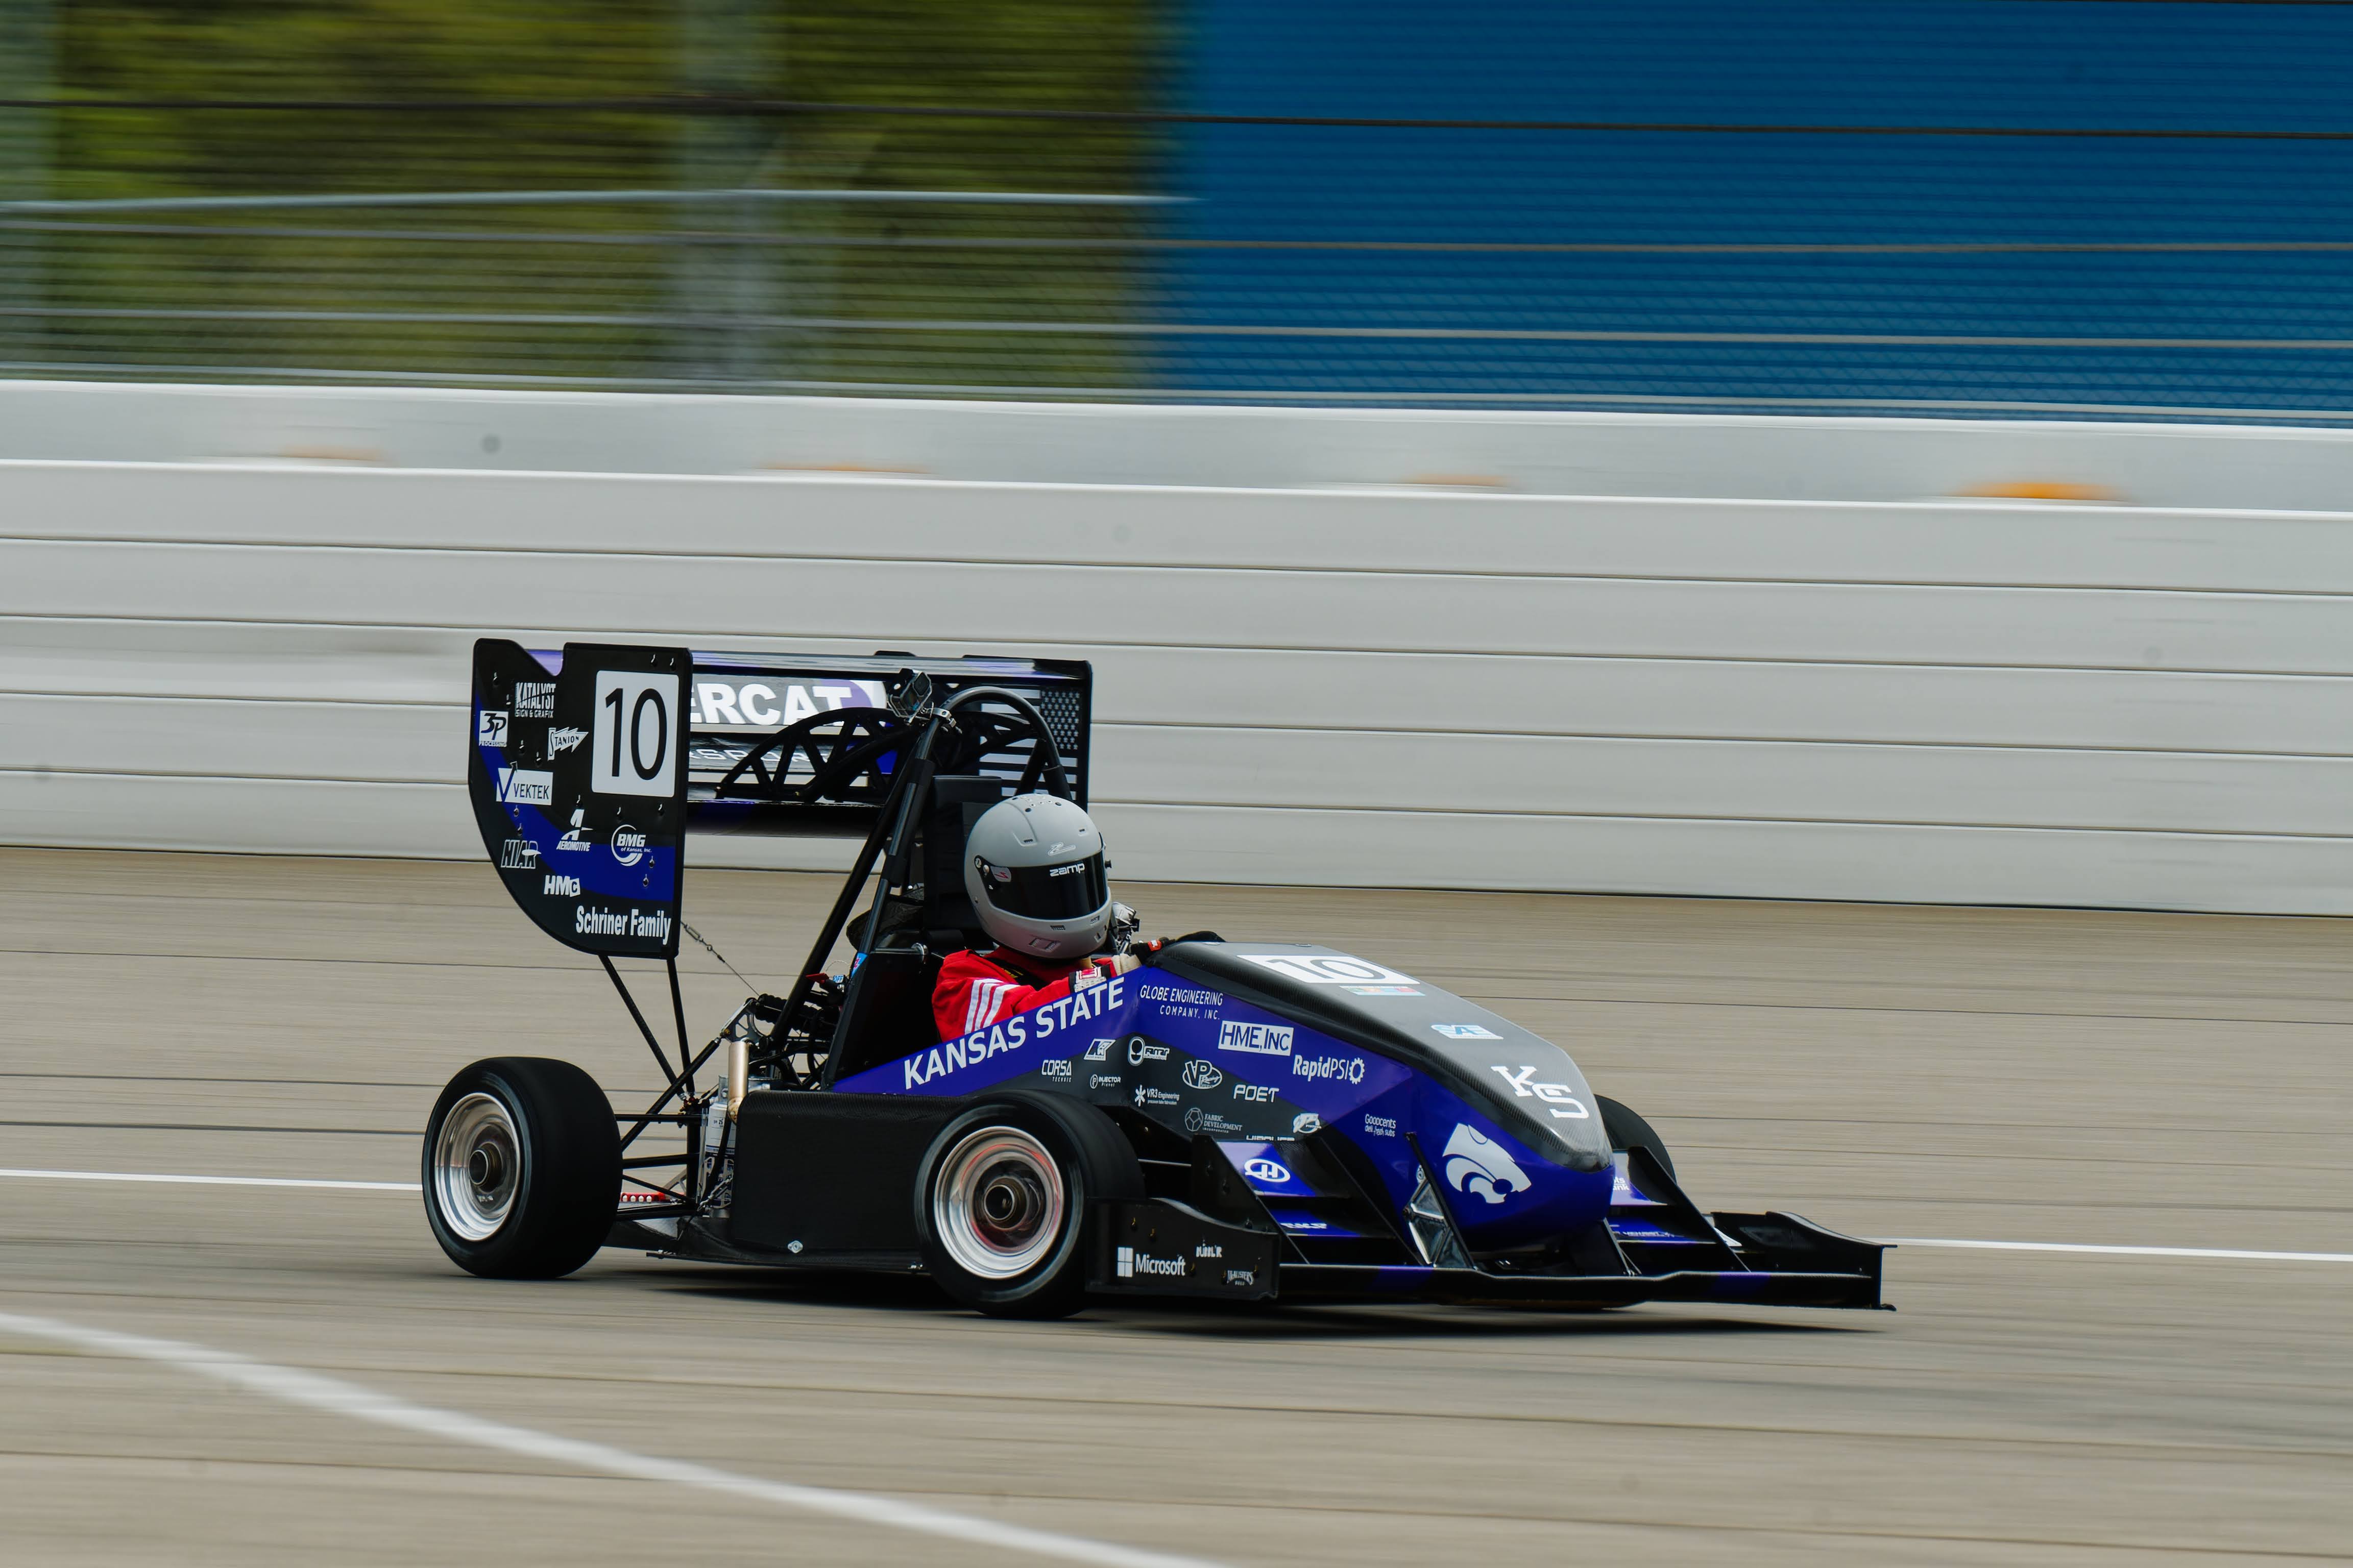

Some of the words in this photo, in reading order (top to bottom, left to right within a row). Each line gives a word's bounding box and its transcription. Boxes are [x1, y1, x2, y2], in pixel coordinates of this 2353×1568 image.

[534, 710, 553, 718] GRAFIX
[481, 713, 506, 740] 3P
[605, 688, 667, 780] 10
[549, 732, 579, 756] STANION
[514, 783, 549, 799] VEKTEK
[556, 841, 591, 851] AEROMOTIVE
[617, 834, 646, 847] BMG
[1050, 863, 1085, 877] zamp
[576, 905, 627, 935] Schriner
[630, 909, 671, 945] Family
[1266, 959, 1386, 980] 10
[1140, 985, 1169, 1001] GLOBE
[1170, 988, 1223, 1006] ENGINEERING
[1204, 1008, 1220, 1020] INC.
[904, 1016, 1026, 1090] KANSAS
[1036, 977, 1124, 1038] STATE
[1041, 1060, 1072, 1076] CORSA
[1184, 1060, 1212, 1087] VP
[1147, 1088, 1158, 1098] VR3
[1158, 1091, 1179, 1101] Engineering
[1233, 1085, 1279, 1102] POET
[1491, 1066, 1589, 1119] KS
[1203, 1120, 1243, 1131] DEVELOPMENT
[1204, 1114, 1224, 1122] FABRIC
[1136, 1254, 1185, 1276] Microsoft
